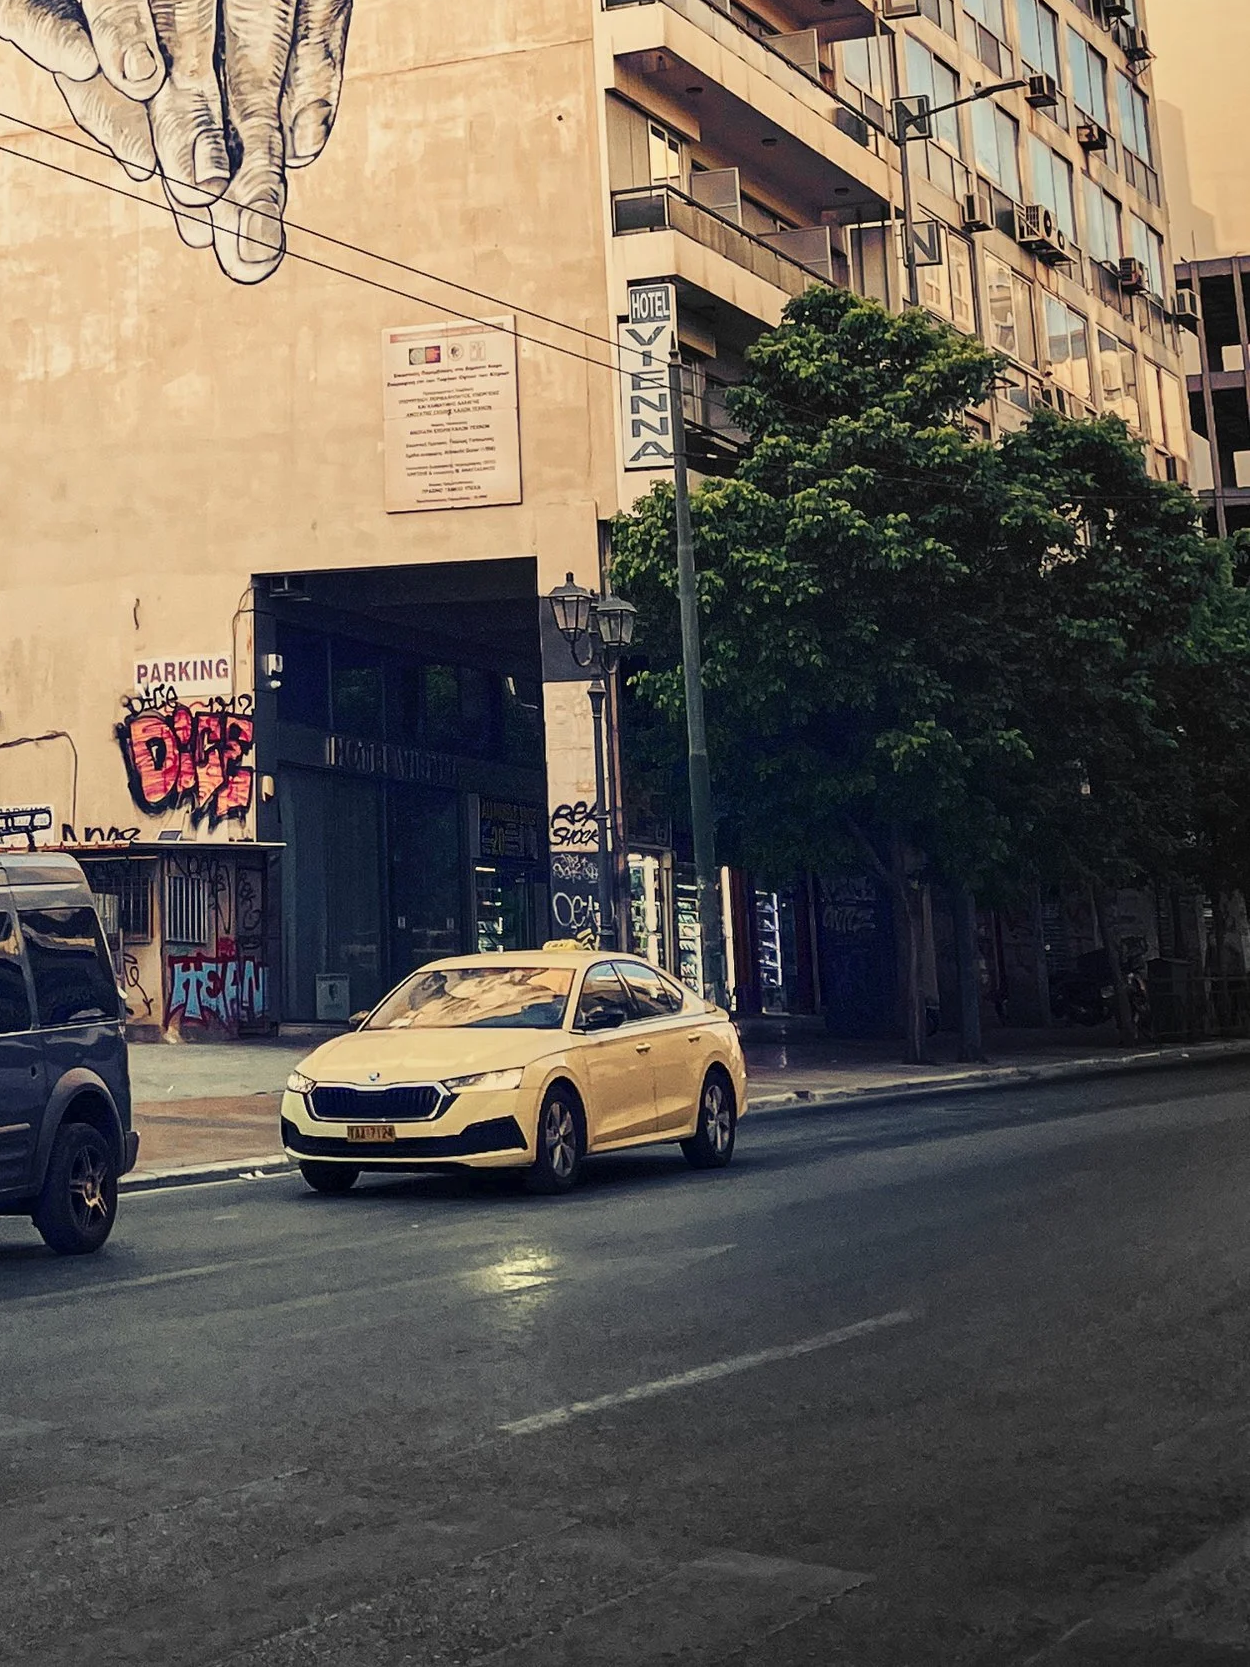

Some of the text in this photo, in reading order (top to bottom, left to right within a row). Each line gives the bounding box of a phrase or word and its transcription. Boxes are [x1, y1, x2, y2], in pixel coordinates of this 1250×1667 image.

[631, 290, 670, 320] HOTEL
[625, 325, 675, 462] VIENNA
[137, 658, 229, 684] PARKING
[550, 827, 600, 846] SHOCK
